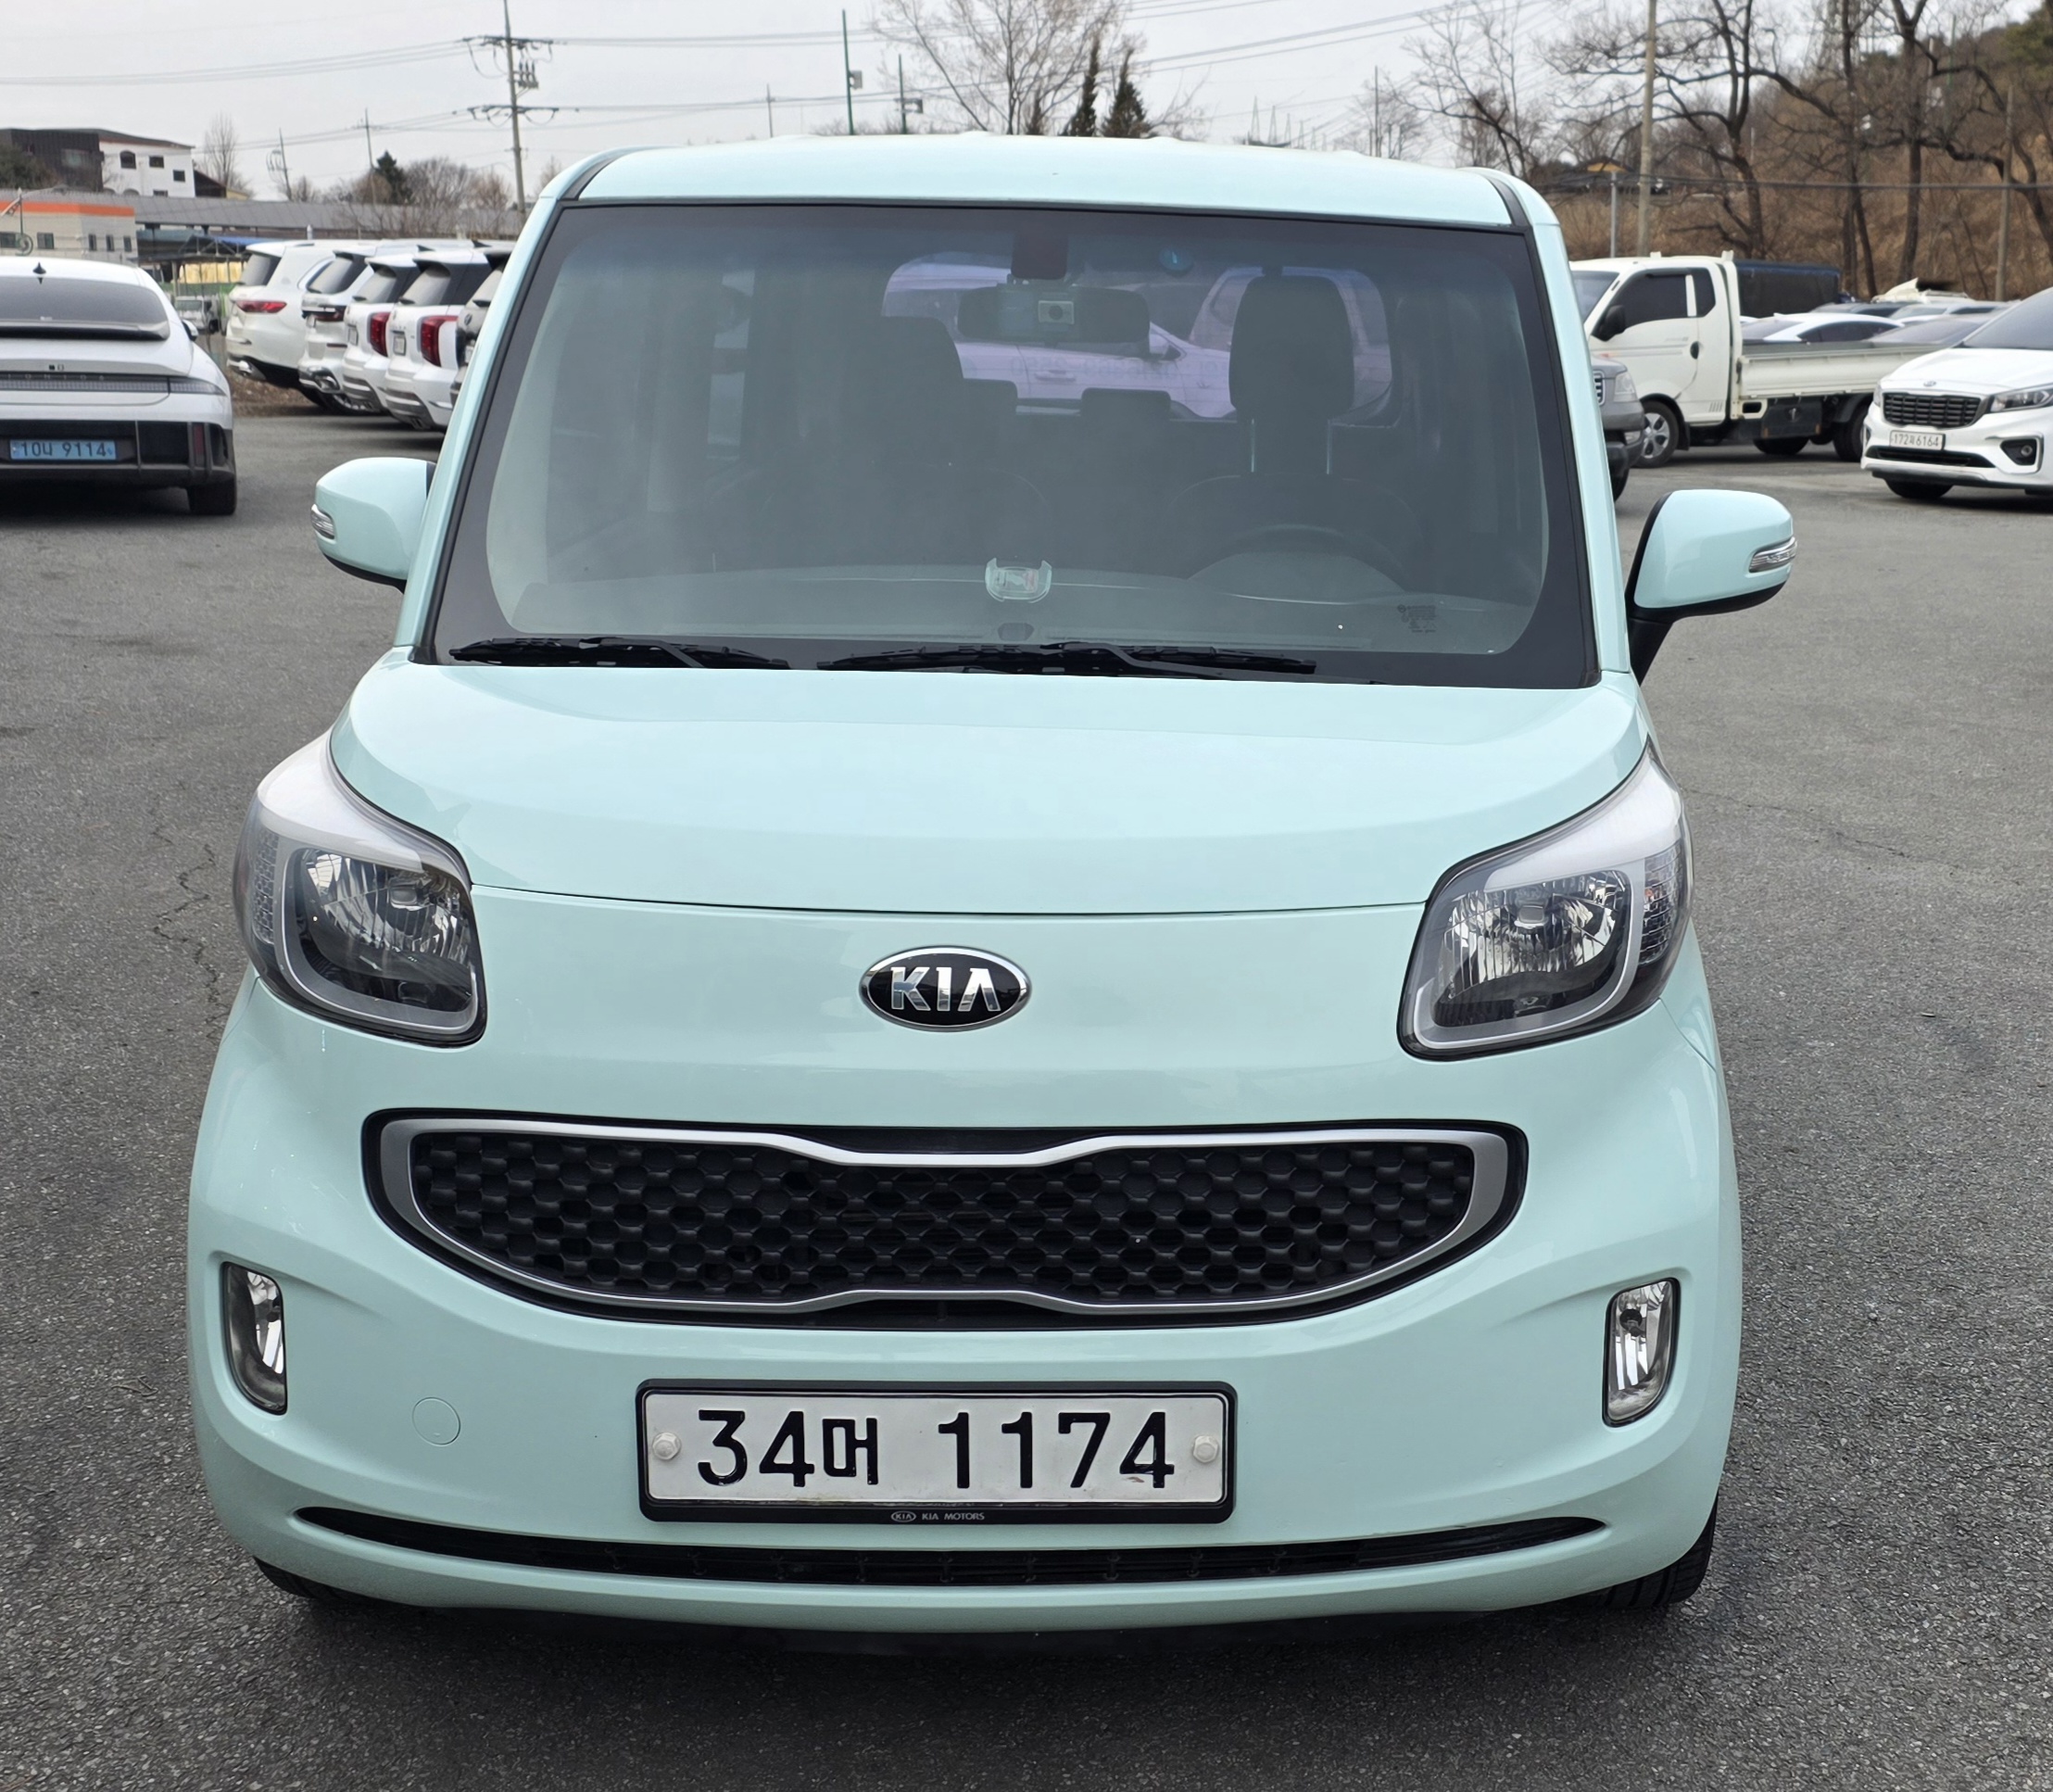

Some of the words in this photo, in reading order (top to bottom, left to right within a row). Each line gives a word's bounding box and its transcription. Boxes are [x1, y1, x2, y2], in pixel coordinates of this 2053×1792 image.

[61, 441, 107, 457] 9114
[890, 966, 1001, 1012] KIA
[697, 1409, 878, 1487] 34머
[938, 1411, 1175, 1489] 1174
[922, 1512, 939, 1521] KIA
[944, 1512, 986, 1521] MOTORS
